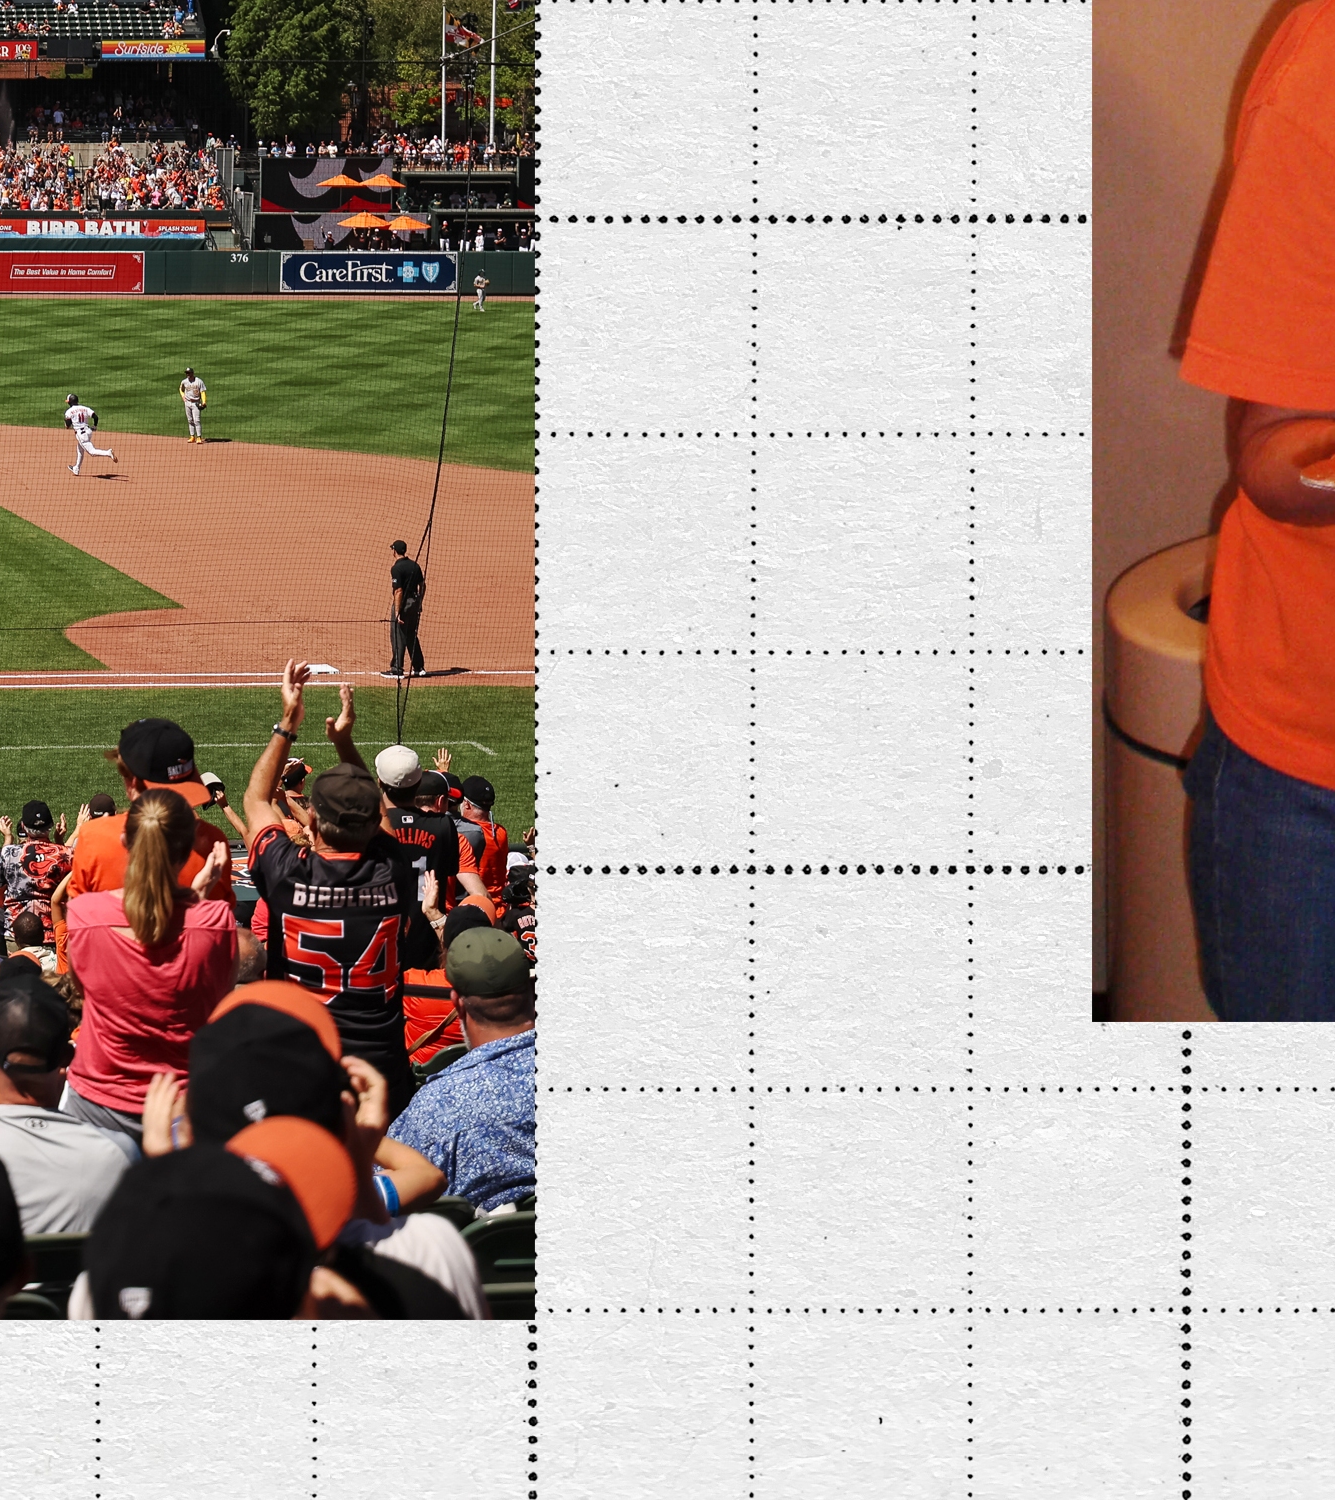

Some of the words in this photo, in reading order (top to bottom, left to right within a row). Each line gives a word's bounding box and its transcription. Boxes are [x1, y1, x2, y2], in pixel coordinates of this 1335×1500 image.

[114, 41, 164, 57] Surfside
[27, 220, 80, 236] BIRD
[84, 220, 141, 236] BATH
[230, 253, 249, 263] 376
[78, 412, 85, 423] 11
[292, 882, 399, 908] BIRDLAND
[282, 913, 401, 1004] 54
